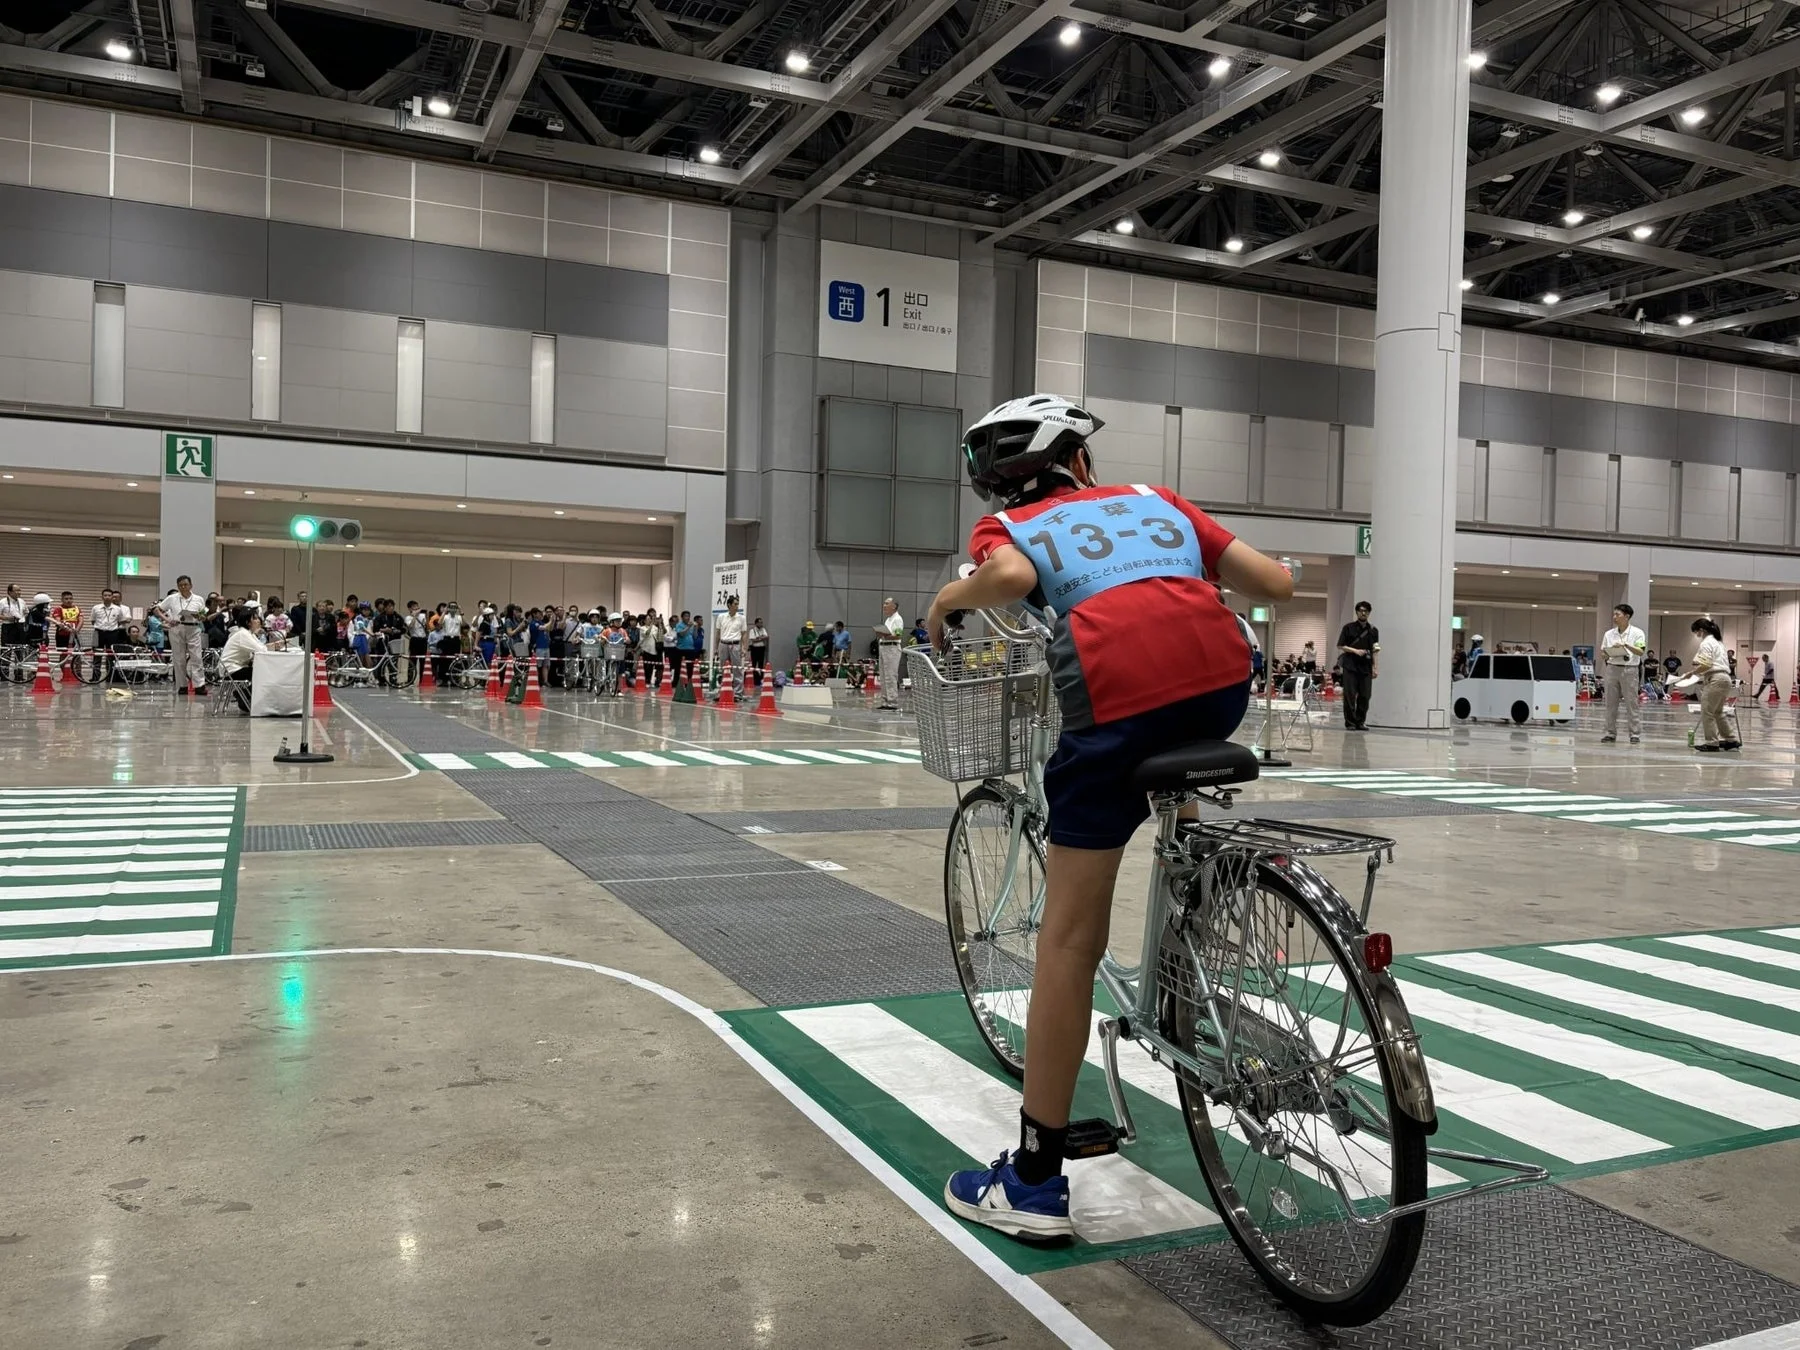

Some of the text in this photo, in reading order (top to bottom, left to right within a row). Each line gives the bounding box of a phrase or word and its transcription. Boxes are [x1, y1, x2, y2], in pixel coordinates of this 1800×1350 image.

[838, 286, 856, 295] West
[903, 291, 929, 307] 出口
[838, 296, 855, 318] 西
[876, 287, 890, 327] 1
[903, 308, 922, 320] Exit
[1028, 517, 1185, 573] 13-3
[1054, 557, 1194, 599] 交通安全こども自転車全国大会
[1185, 767, 1235, 779] BRIDGESTONE
